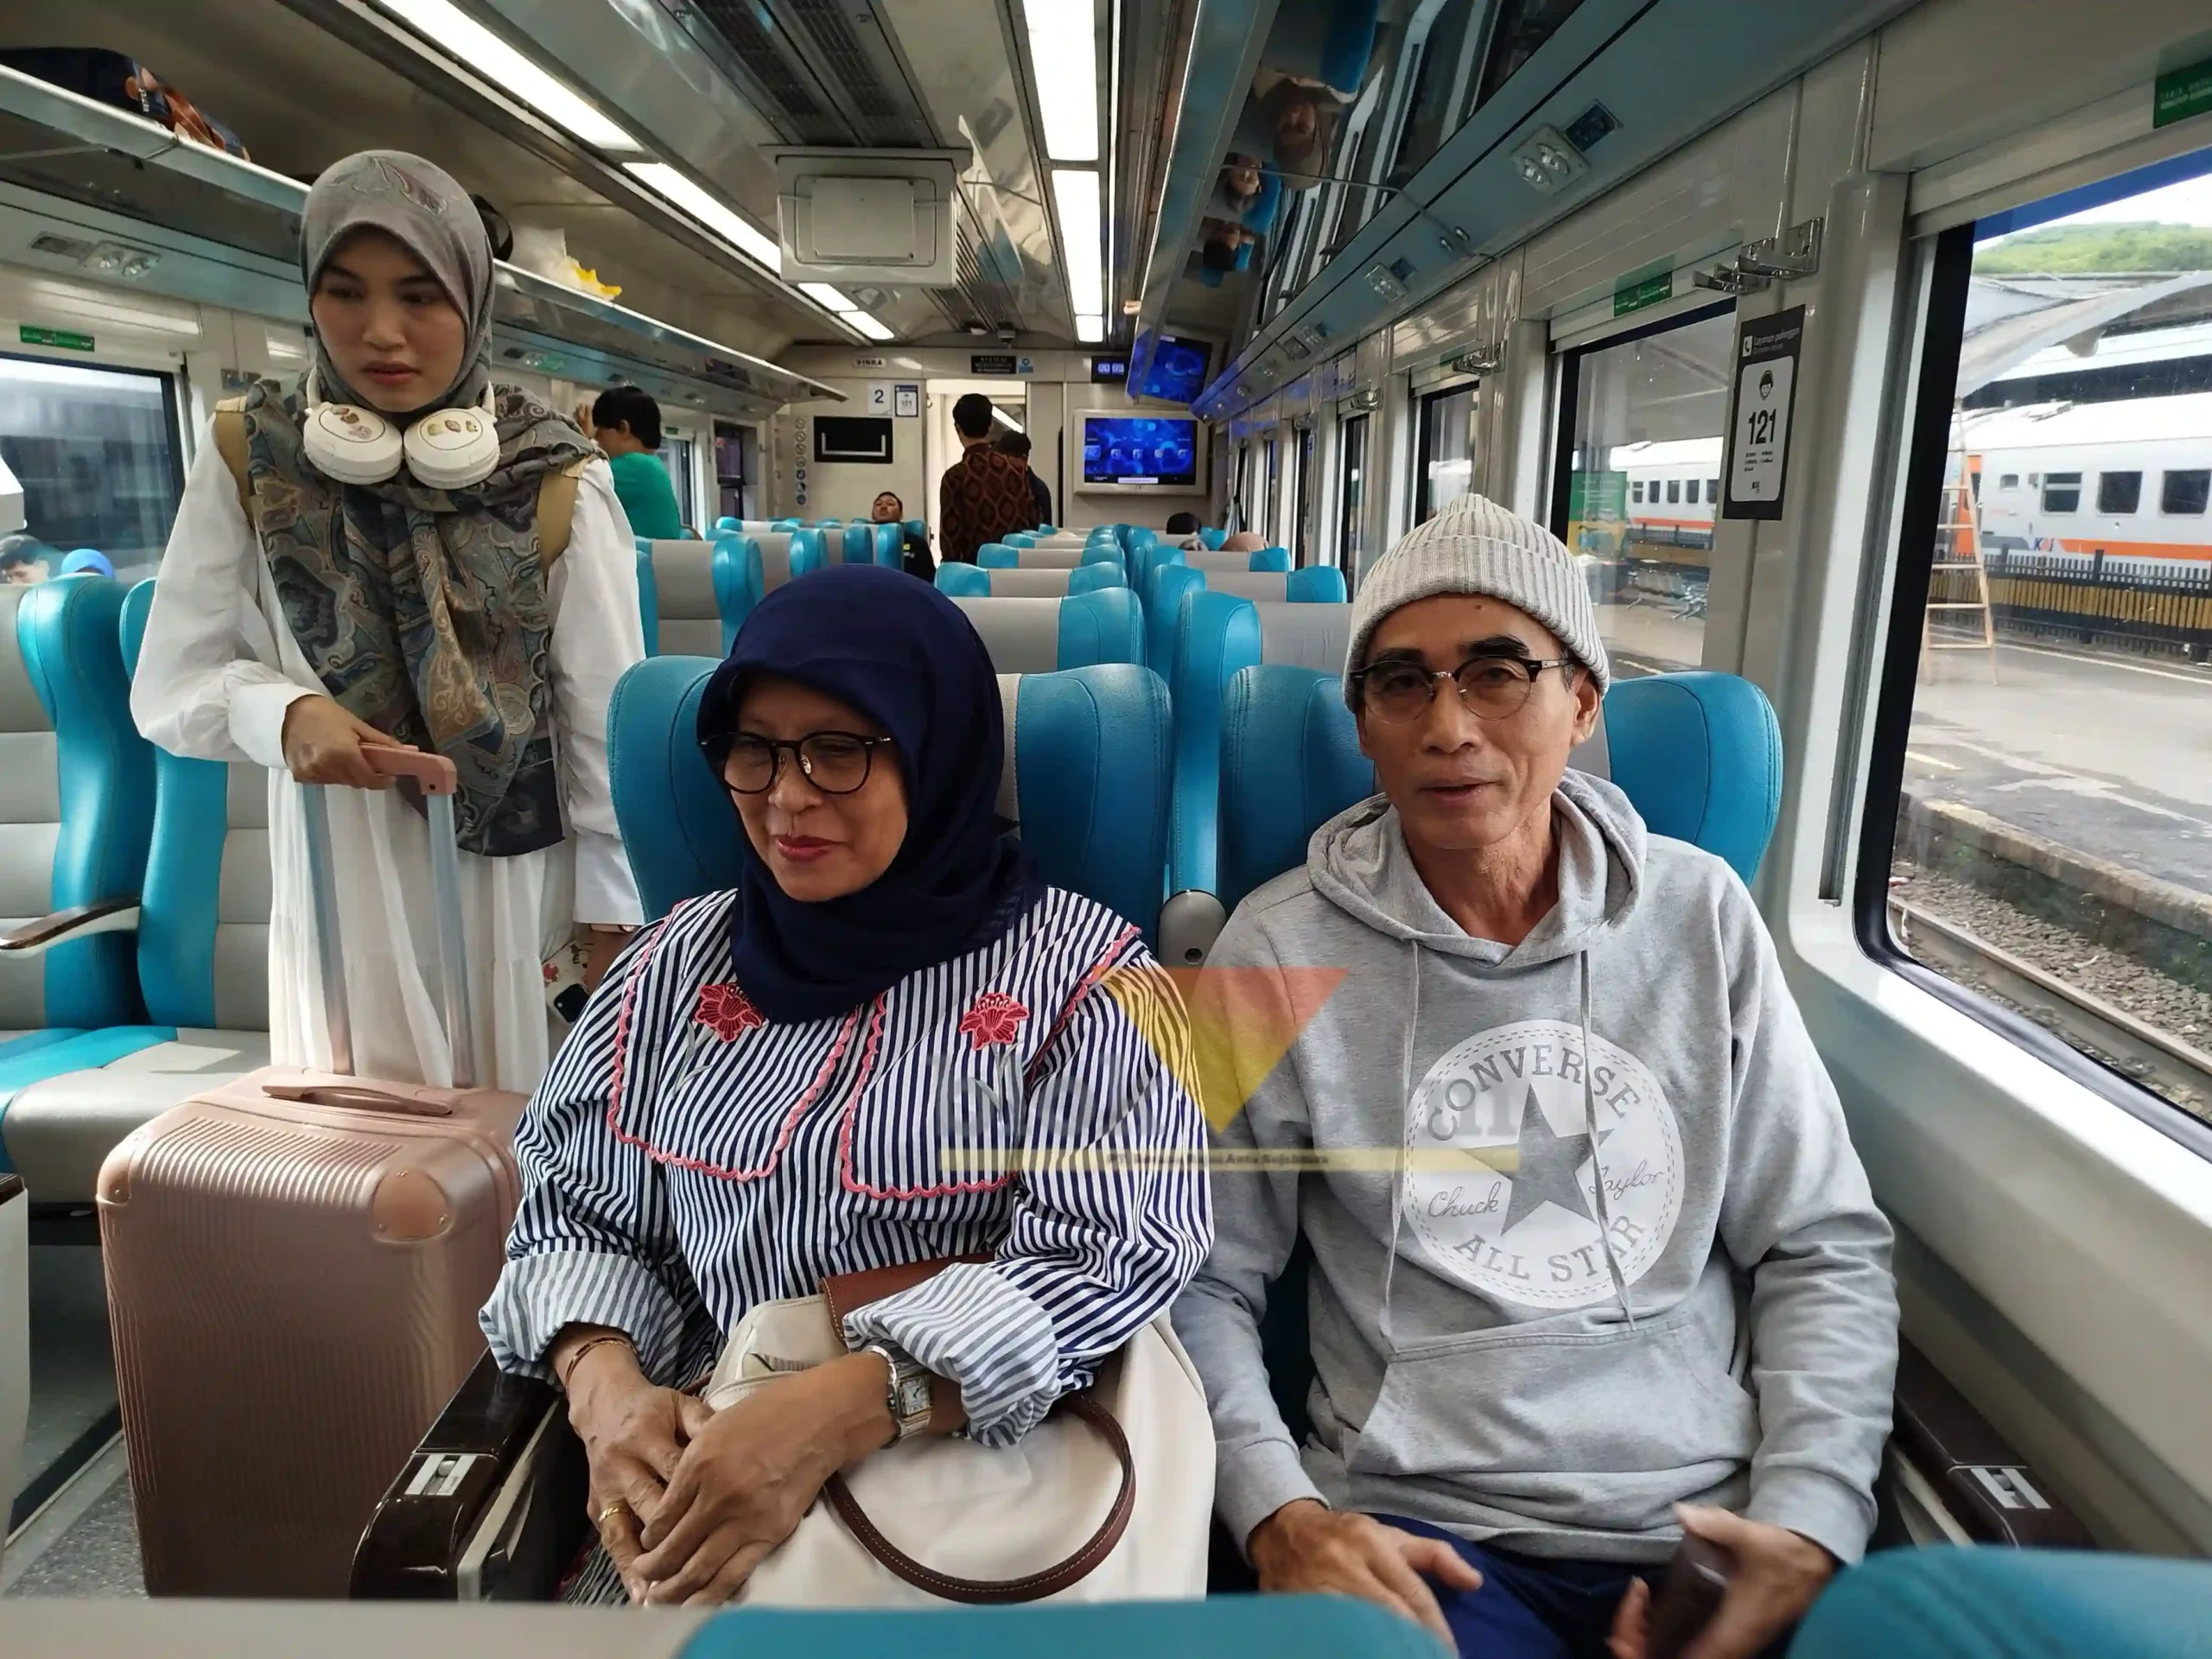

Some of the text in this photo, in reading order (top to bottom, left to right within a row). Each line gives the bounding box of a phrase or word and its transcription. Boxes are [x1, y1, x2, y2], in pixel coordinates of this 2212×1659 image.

[874, 389, 884, 404] 2
[1748, 408, 1777, 445] 121
[1427, 1044, 1641, 1141] CONVERSE
[1427, 1181, 1502, 1218] Chuck
[1453, 1234, 1530, 1281] ALL
